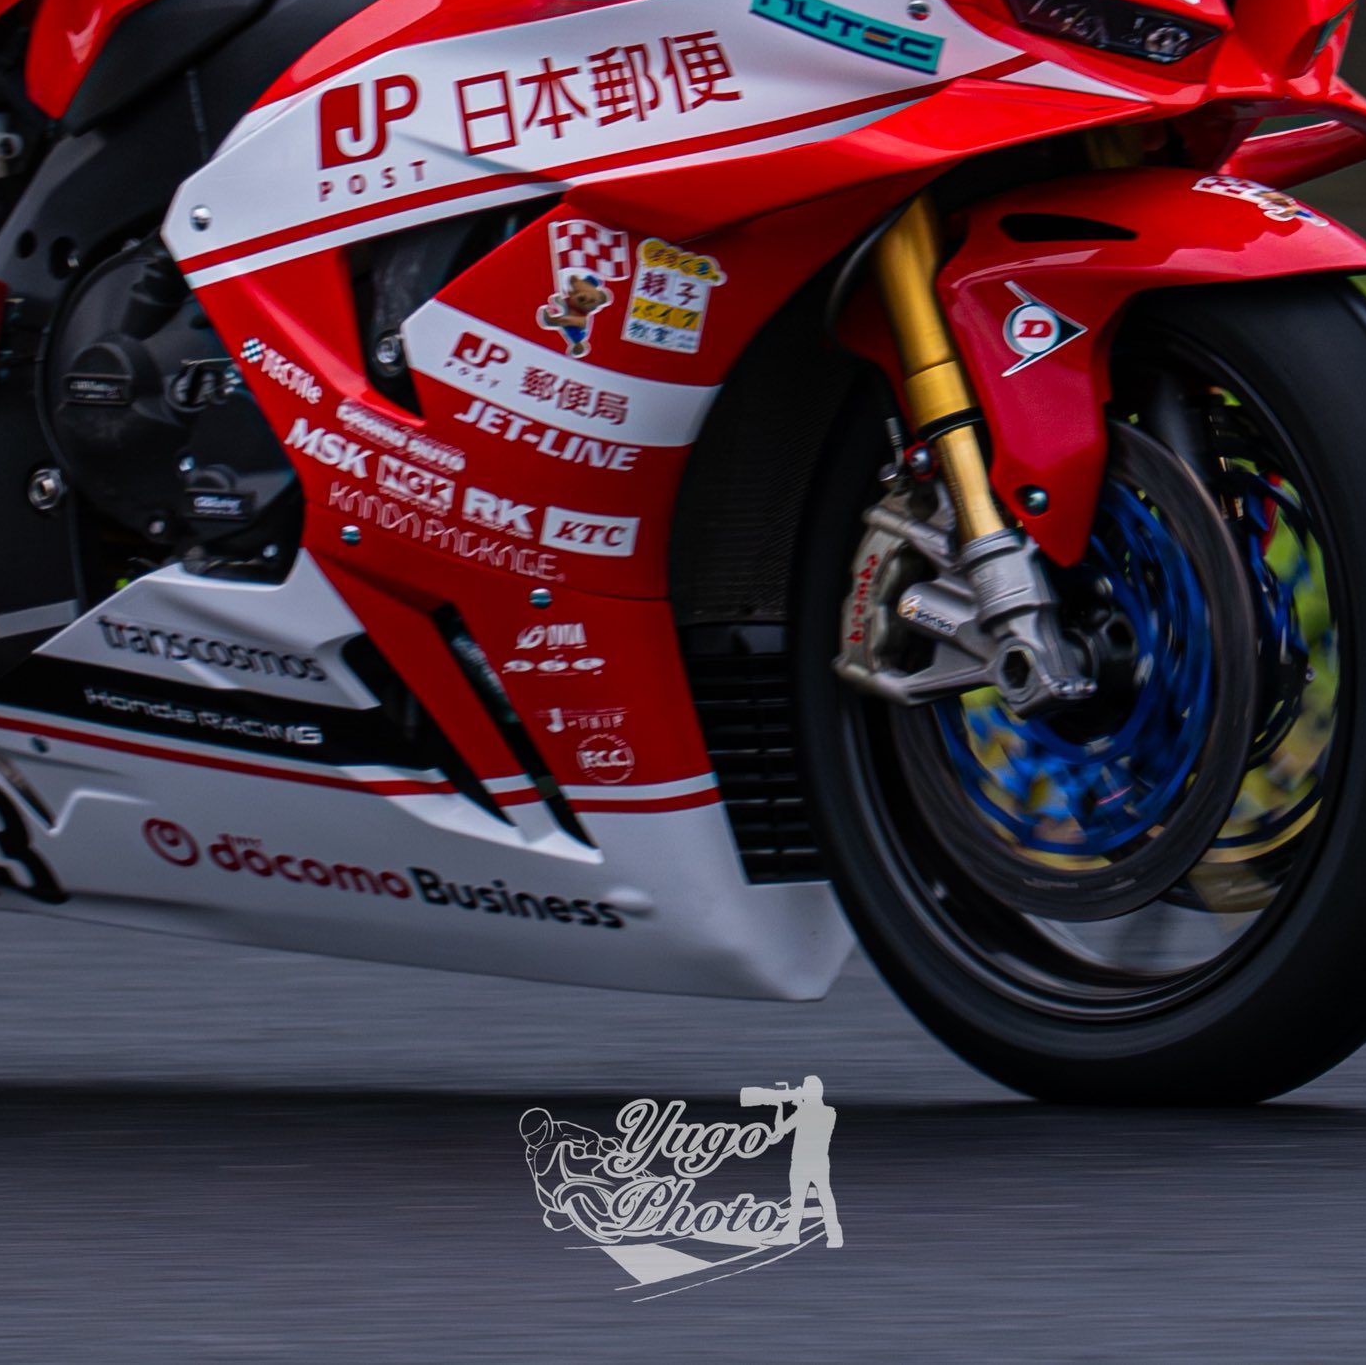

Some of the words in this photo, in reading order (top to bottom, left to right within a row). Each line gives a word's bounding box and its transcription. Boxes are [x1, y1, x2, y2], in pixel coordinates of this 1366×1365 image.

[316, 74, 419, 171] JP
[456, 30, 742, 157] 日本郵便
[319, 159, 427, 203] POST
[444, 360, 501, 388] POST
[451, 331, 512, 369] JP
[519, 365, 630, 425] 郵便局
[284, 417, 373, 479] MSK
[453, 399, 642, 472] JET-LINE
[376, 455, 455, 509] NGK
[462, 486, 538, 535] RK
[551, 520, 625, 547] KTC
[98, 614, 329, 682] transcosmos
[198, 710, 324, 746] RACING
[209, 831, 412, 899] docomo
[409, 866, 625, 930] Business
